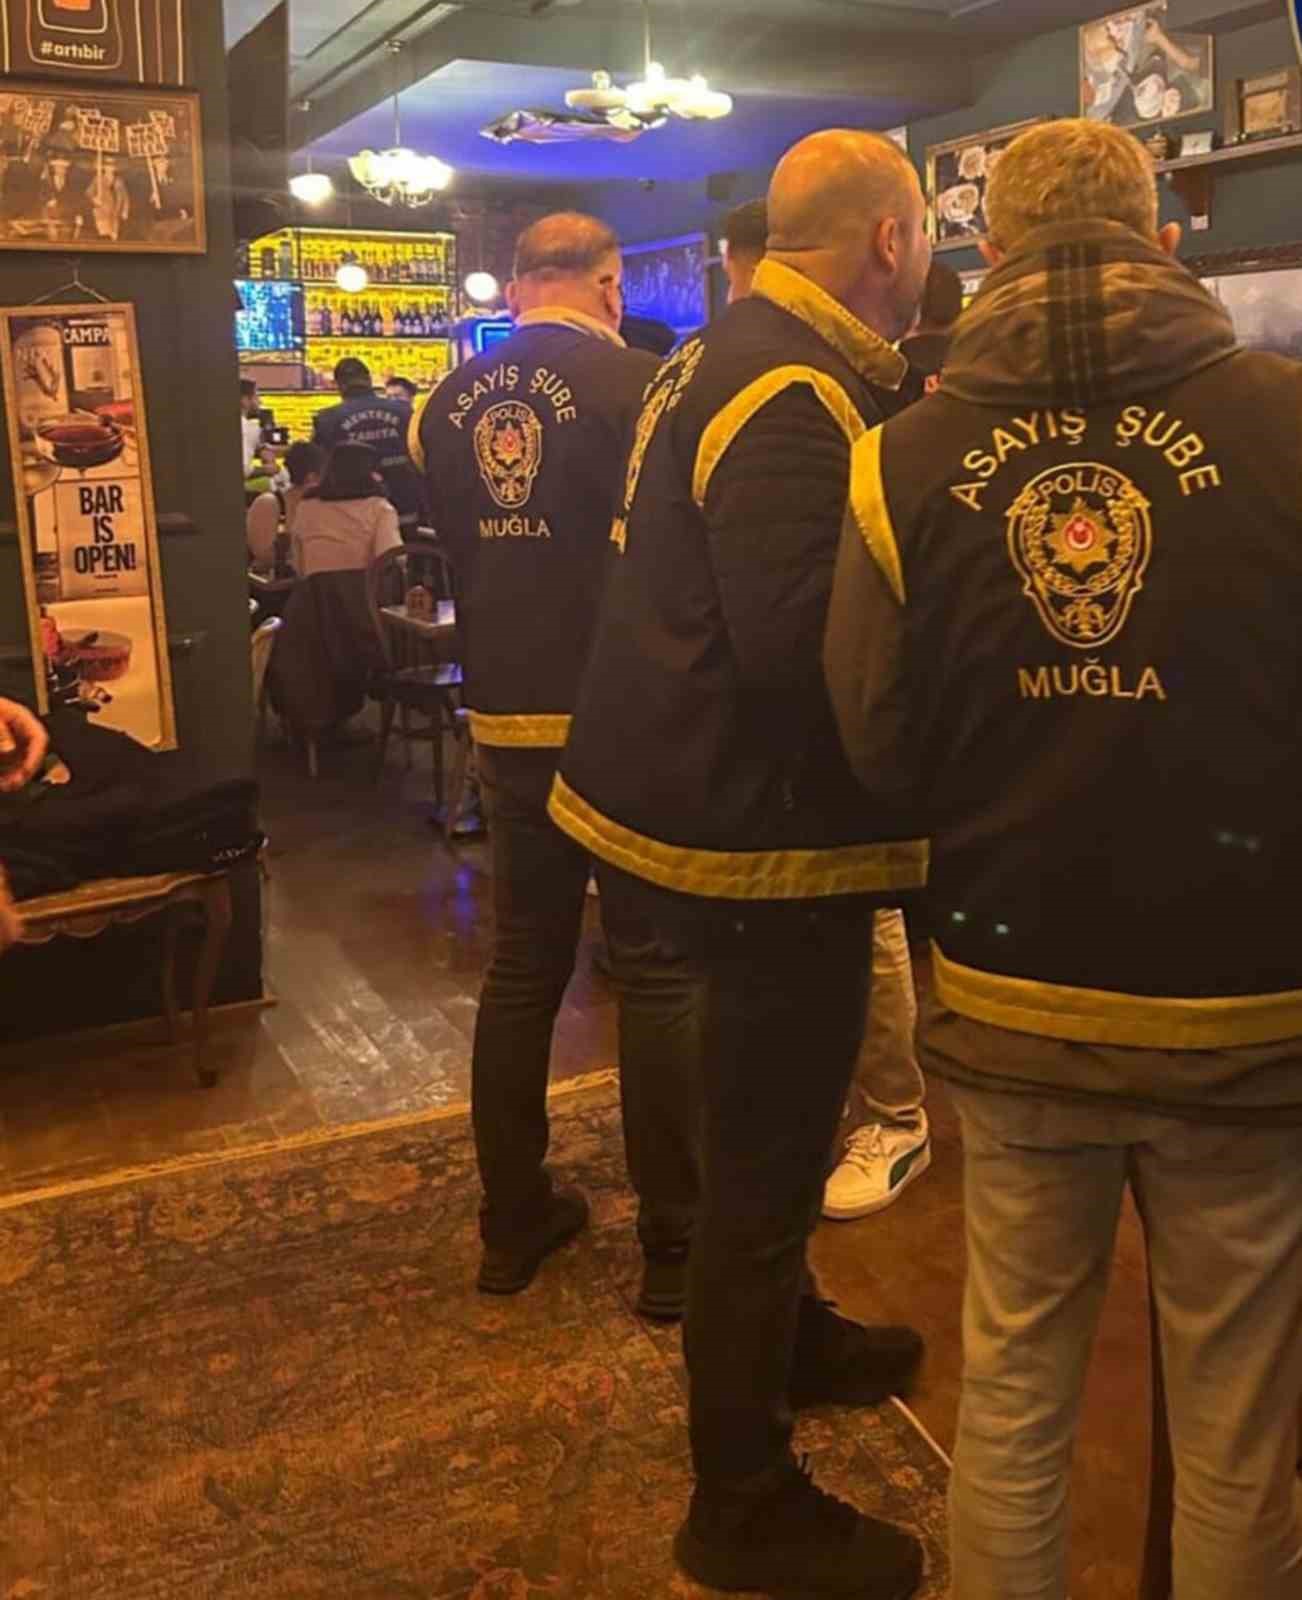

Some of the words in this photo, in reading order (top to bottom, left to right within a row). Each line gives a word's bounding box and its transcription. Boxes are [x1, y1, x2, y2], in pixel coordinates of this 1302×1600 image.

[448, 363, 520, 430] ASAYİŞ
[530, 367, 577, 424] ŞUBE
[1116, 405, 1221, 496] ŞUBE
[79, 485, 124, 515] BAR
[94, 516, 114, 544] IS
[479, 513, 552, 538] MUĞLA
[74, 544, 136, 574] OPEN!
[1017, 657, 1167, 701] MUĞLA
